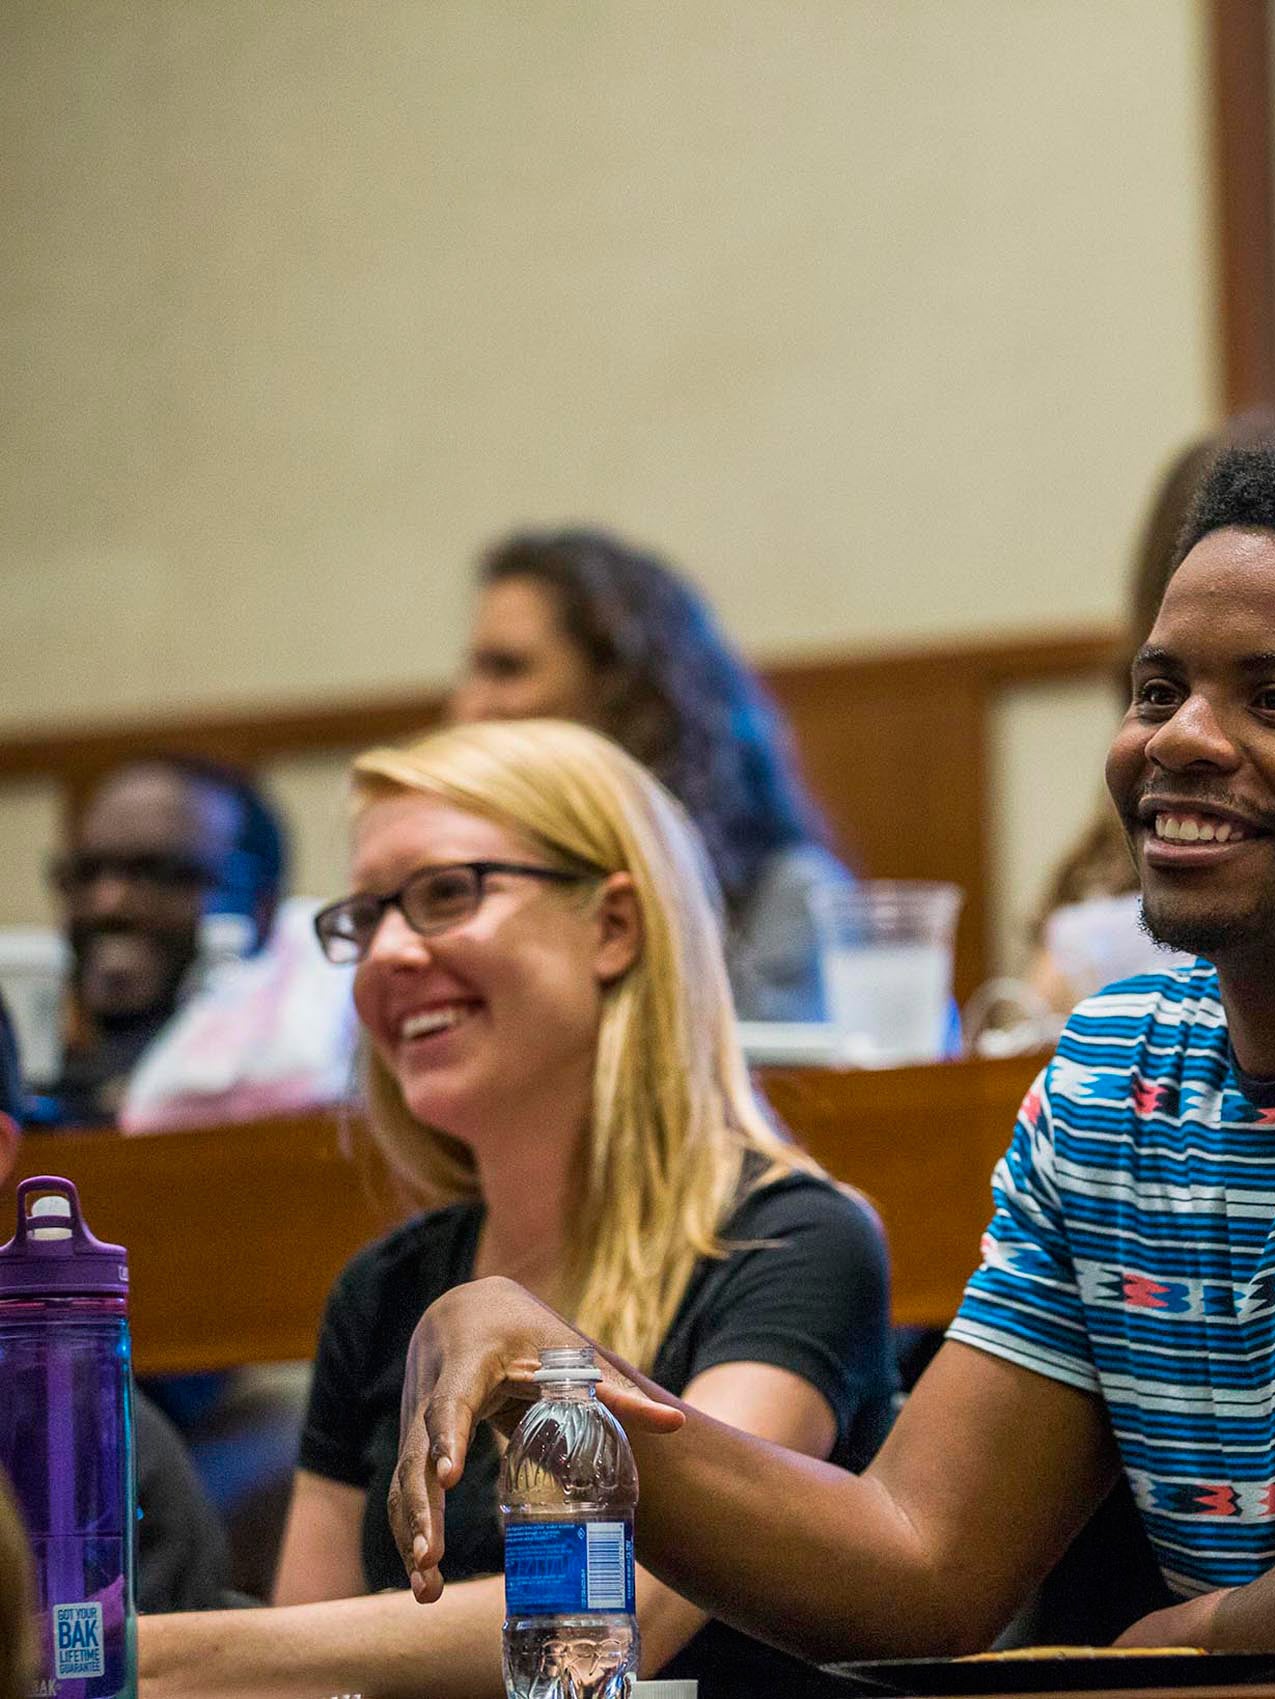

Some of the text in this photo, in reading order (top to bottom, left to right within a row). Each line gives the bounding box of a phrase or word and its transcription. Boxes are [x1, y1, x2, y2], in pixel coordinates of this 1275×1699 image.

[58, 1607, 97, 1620] GOT YOUR
[58, 1620, 98, 1648] BAK
[59, 1648, 100, 1663] LIFETIME
[59, 1661, 101, 1674] GUARANTEE
